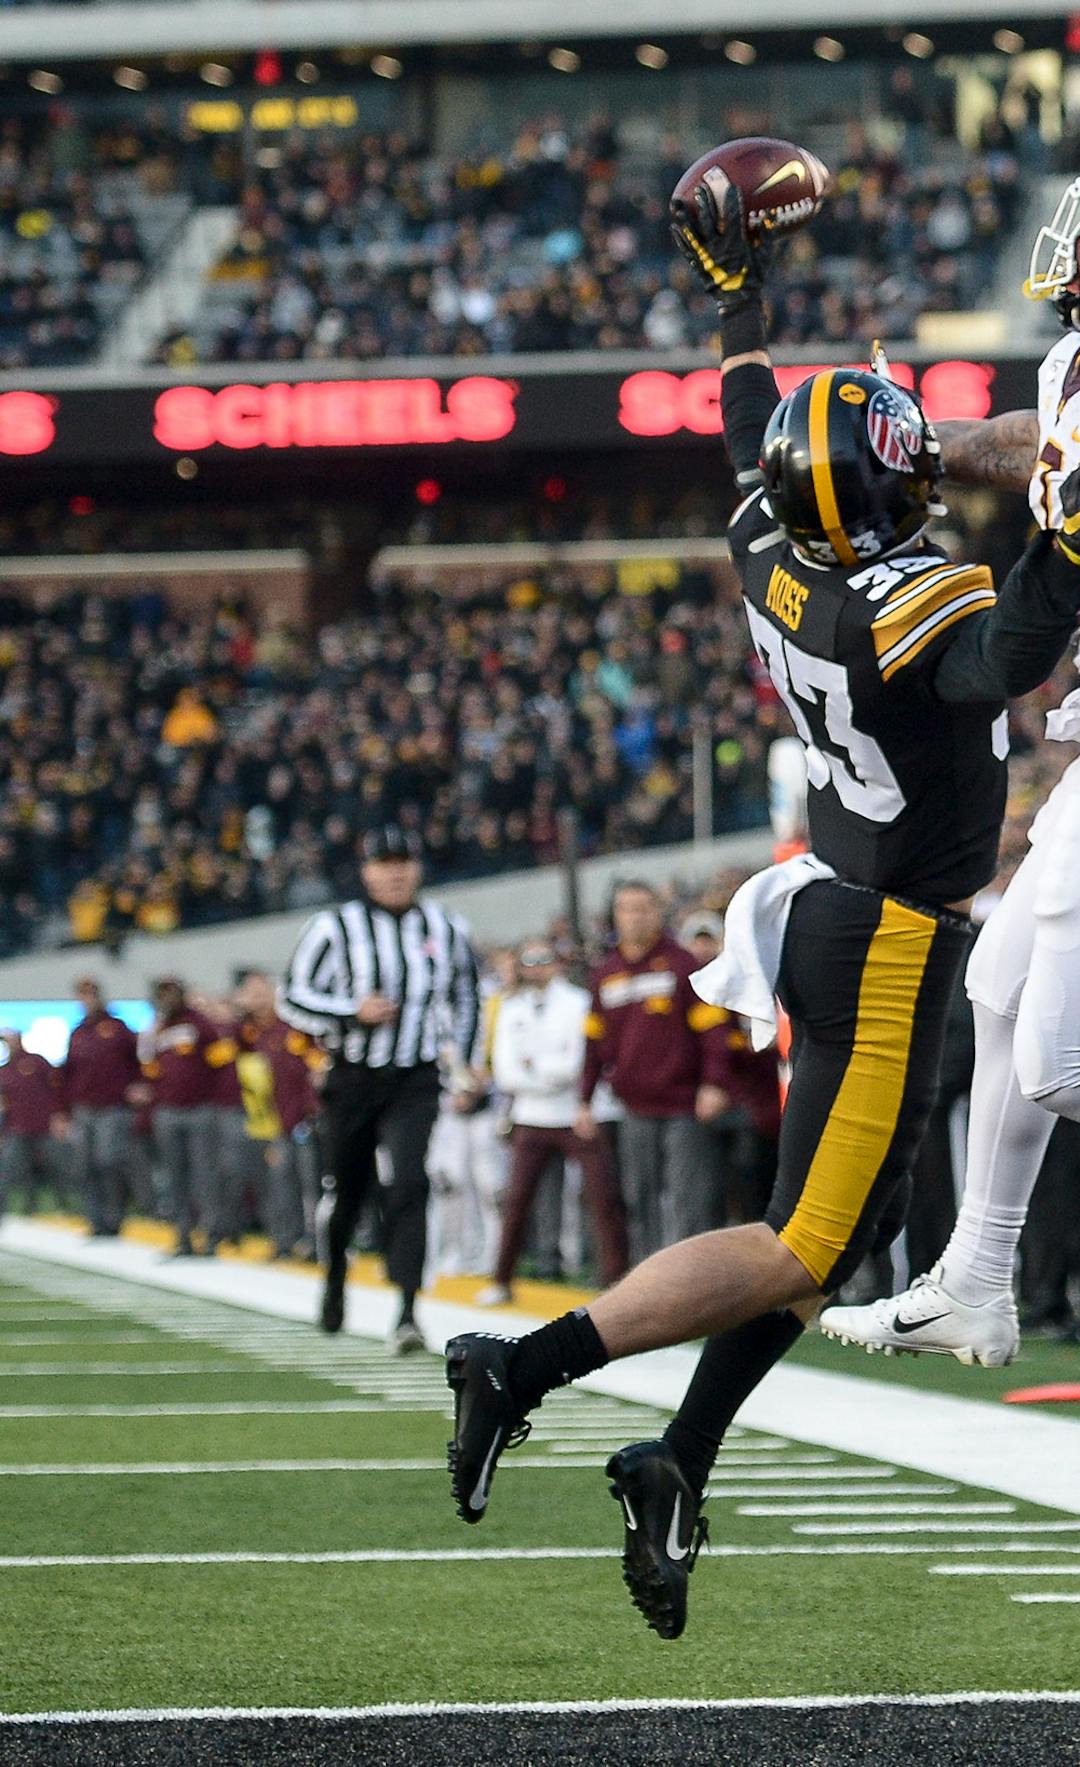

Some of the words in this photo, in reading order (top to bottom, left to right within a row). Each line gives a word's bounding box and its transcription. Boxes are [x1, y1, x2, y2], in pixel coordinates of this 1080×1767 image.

[153, 376, 518, 451] SCHEELS
[808, 530, 881, 563] 33
[765, 563, 811, 632] MOSS
